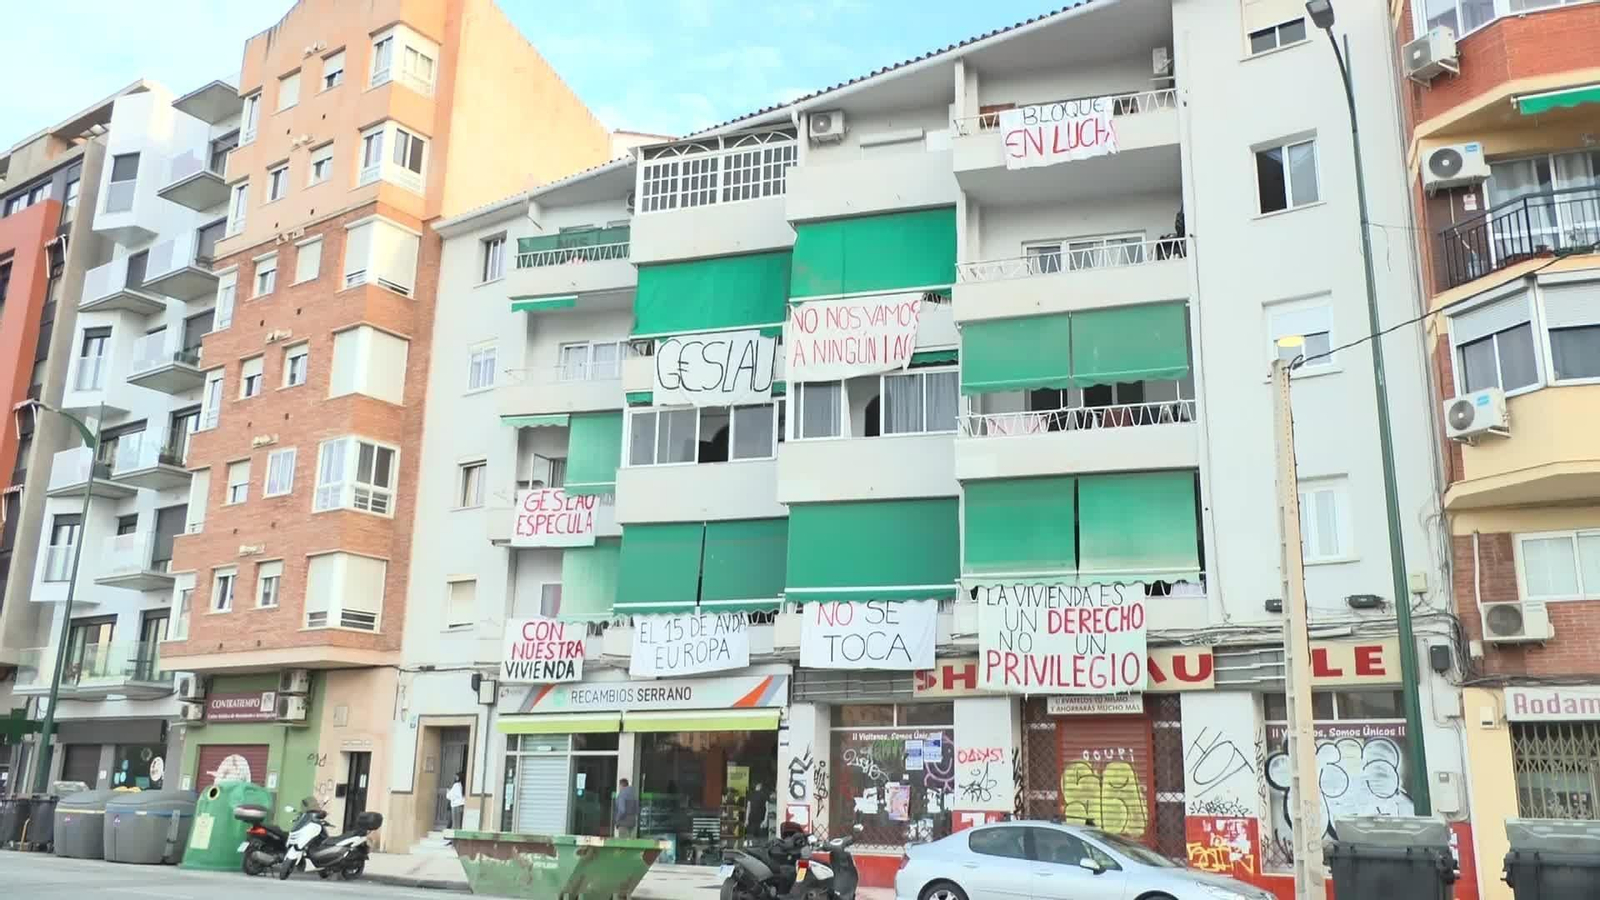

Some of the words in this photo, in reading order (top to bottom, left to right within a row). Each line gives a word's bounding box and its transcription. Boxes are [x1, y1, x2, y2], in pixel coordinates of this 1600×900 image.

[1023, 98, 1104, 125] BLOQUE
[1005, 126, 1043, 158] EN
[791, 308, 819, 334] NO
[826, 305, 861, 330] NOS
[793, 339, 806, 368] A
[516, 511, 593, 537] ESPECULA
[986, 585, 1009, 606] LA
[1013, 584, 1094, 609] VIVIENDA
[1100, 583, 1125, 608] ES
[817, 601, 853, 627] NO
[865, 600, 904, 625] SE
[1004, 606, 1037, 634] UN
[1046, 602, 1144, 635] DERECHO
[522, 621, 565, 642] CON
[640, 621, 657, 645] EL
[665, 617, 684, 643] 15
[690, 614, 708, 638] DE
[999, 630, 1033, 654] NO
[1075, 632, 1107, 655] UN
[511, 640, 585, 660] NUESTRA
[655, 637, 731, 670] EUROPA
[823, 631, 912, 662] TOCA
[504, 660, 575, 679] VIVIENDA
[986, 649, 1140, 689] PRIVILEGIO
[211, 698, 260, 709] CONTRATIEMPO
[571, 688, 634, 704] RECAMBIOS
[637, 686, 692, 702] SERRANO
[1328, 727, 1361, 738] Somos
[1362, 724, 1396, 737] Únicos
